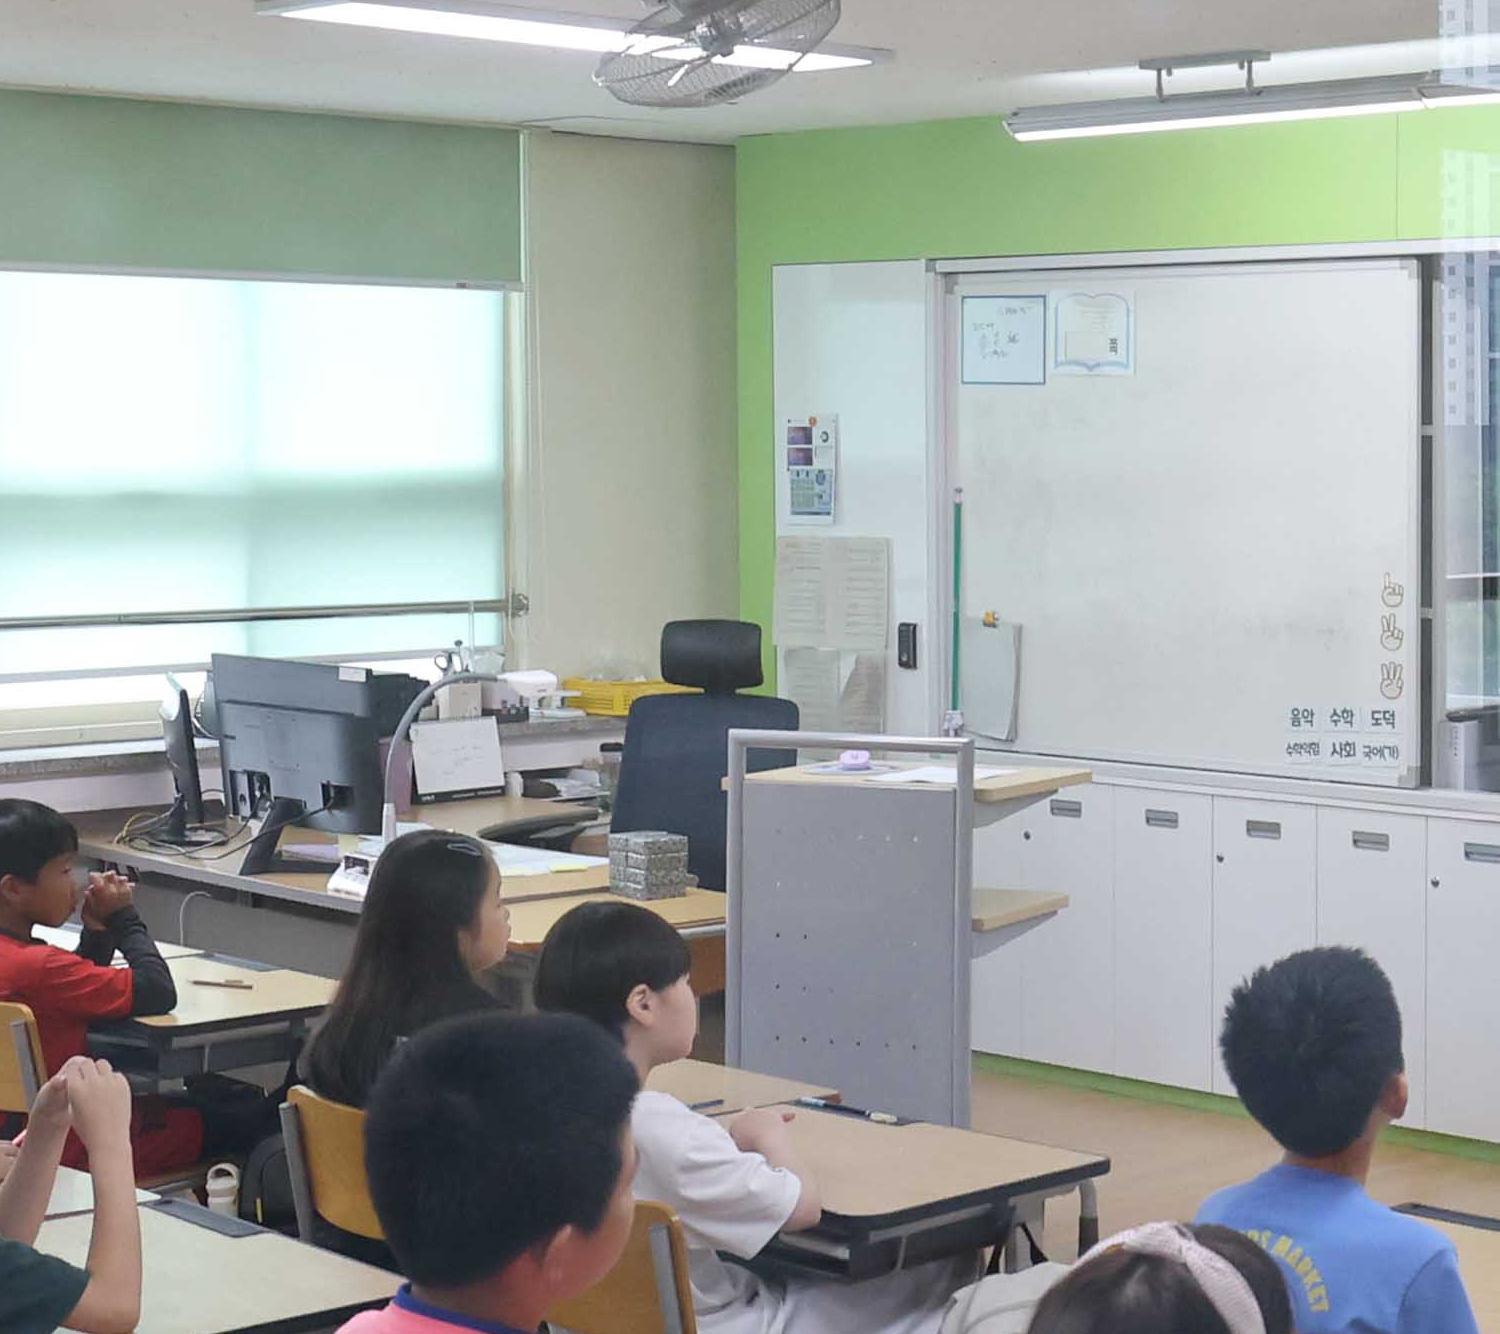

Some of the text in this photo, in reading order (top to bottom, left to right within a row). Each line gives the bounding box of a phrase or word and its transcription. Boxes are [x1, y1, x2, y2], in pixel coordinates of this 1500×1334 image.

[1289, 707, 1315, 728] 음악
[1330, 707, 1354, 728] 수학
[1371, 709, 1396, 729] 도덕
[1331, 741, 1356, 759] 사회
[1269, 1235, 1330, 1311] MARKET
